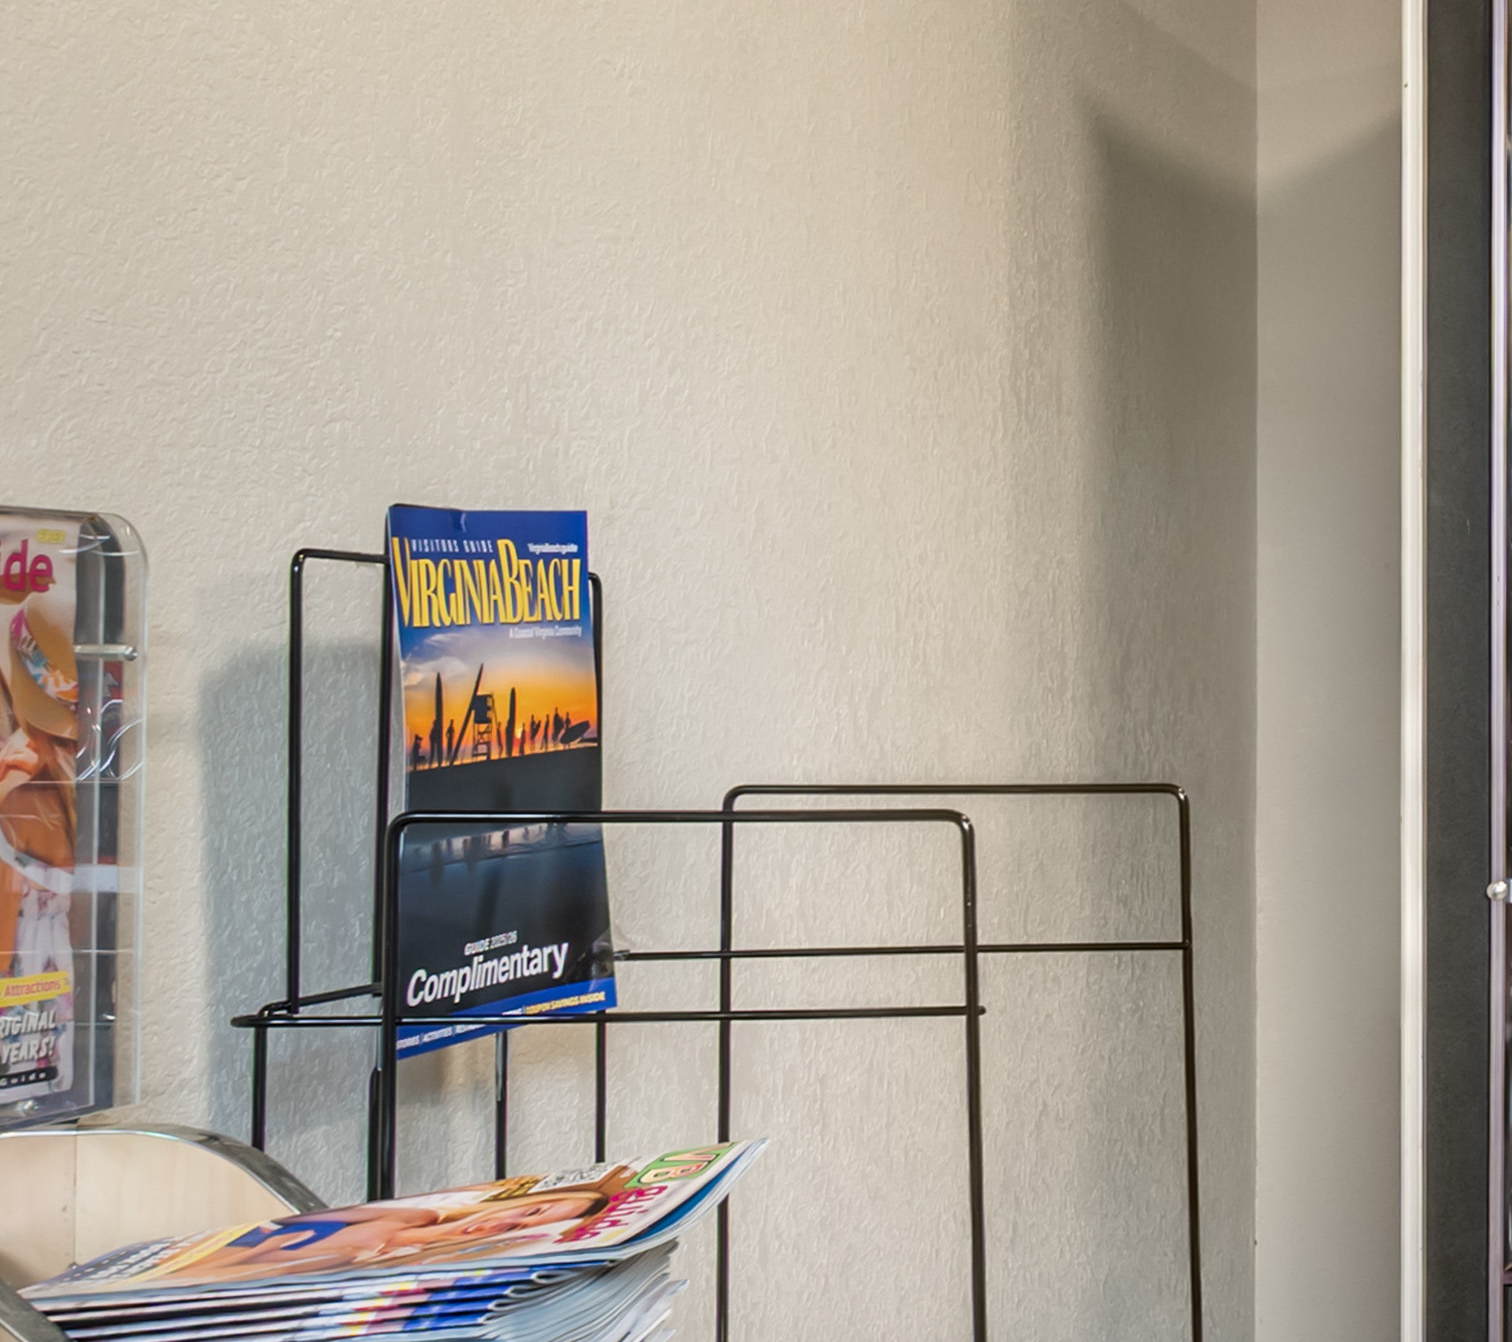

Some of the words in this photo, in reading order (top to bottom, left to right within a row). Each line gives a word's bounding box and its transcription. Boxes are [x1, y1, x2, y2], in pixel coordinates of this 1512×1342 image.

[412, 539, 459, 553] VISITORS
[464, 540, 493, 553] GUIDE
[407, 942, 569, 1007] Complimentary
[2, 1035, 56, 1064] YEARS!
